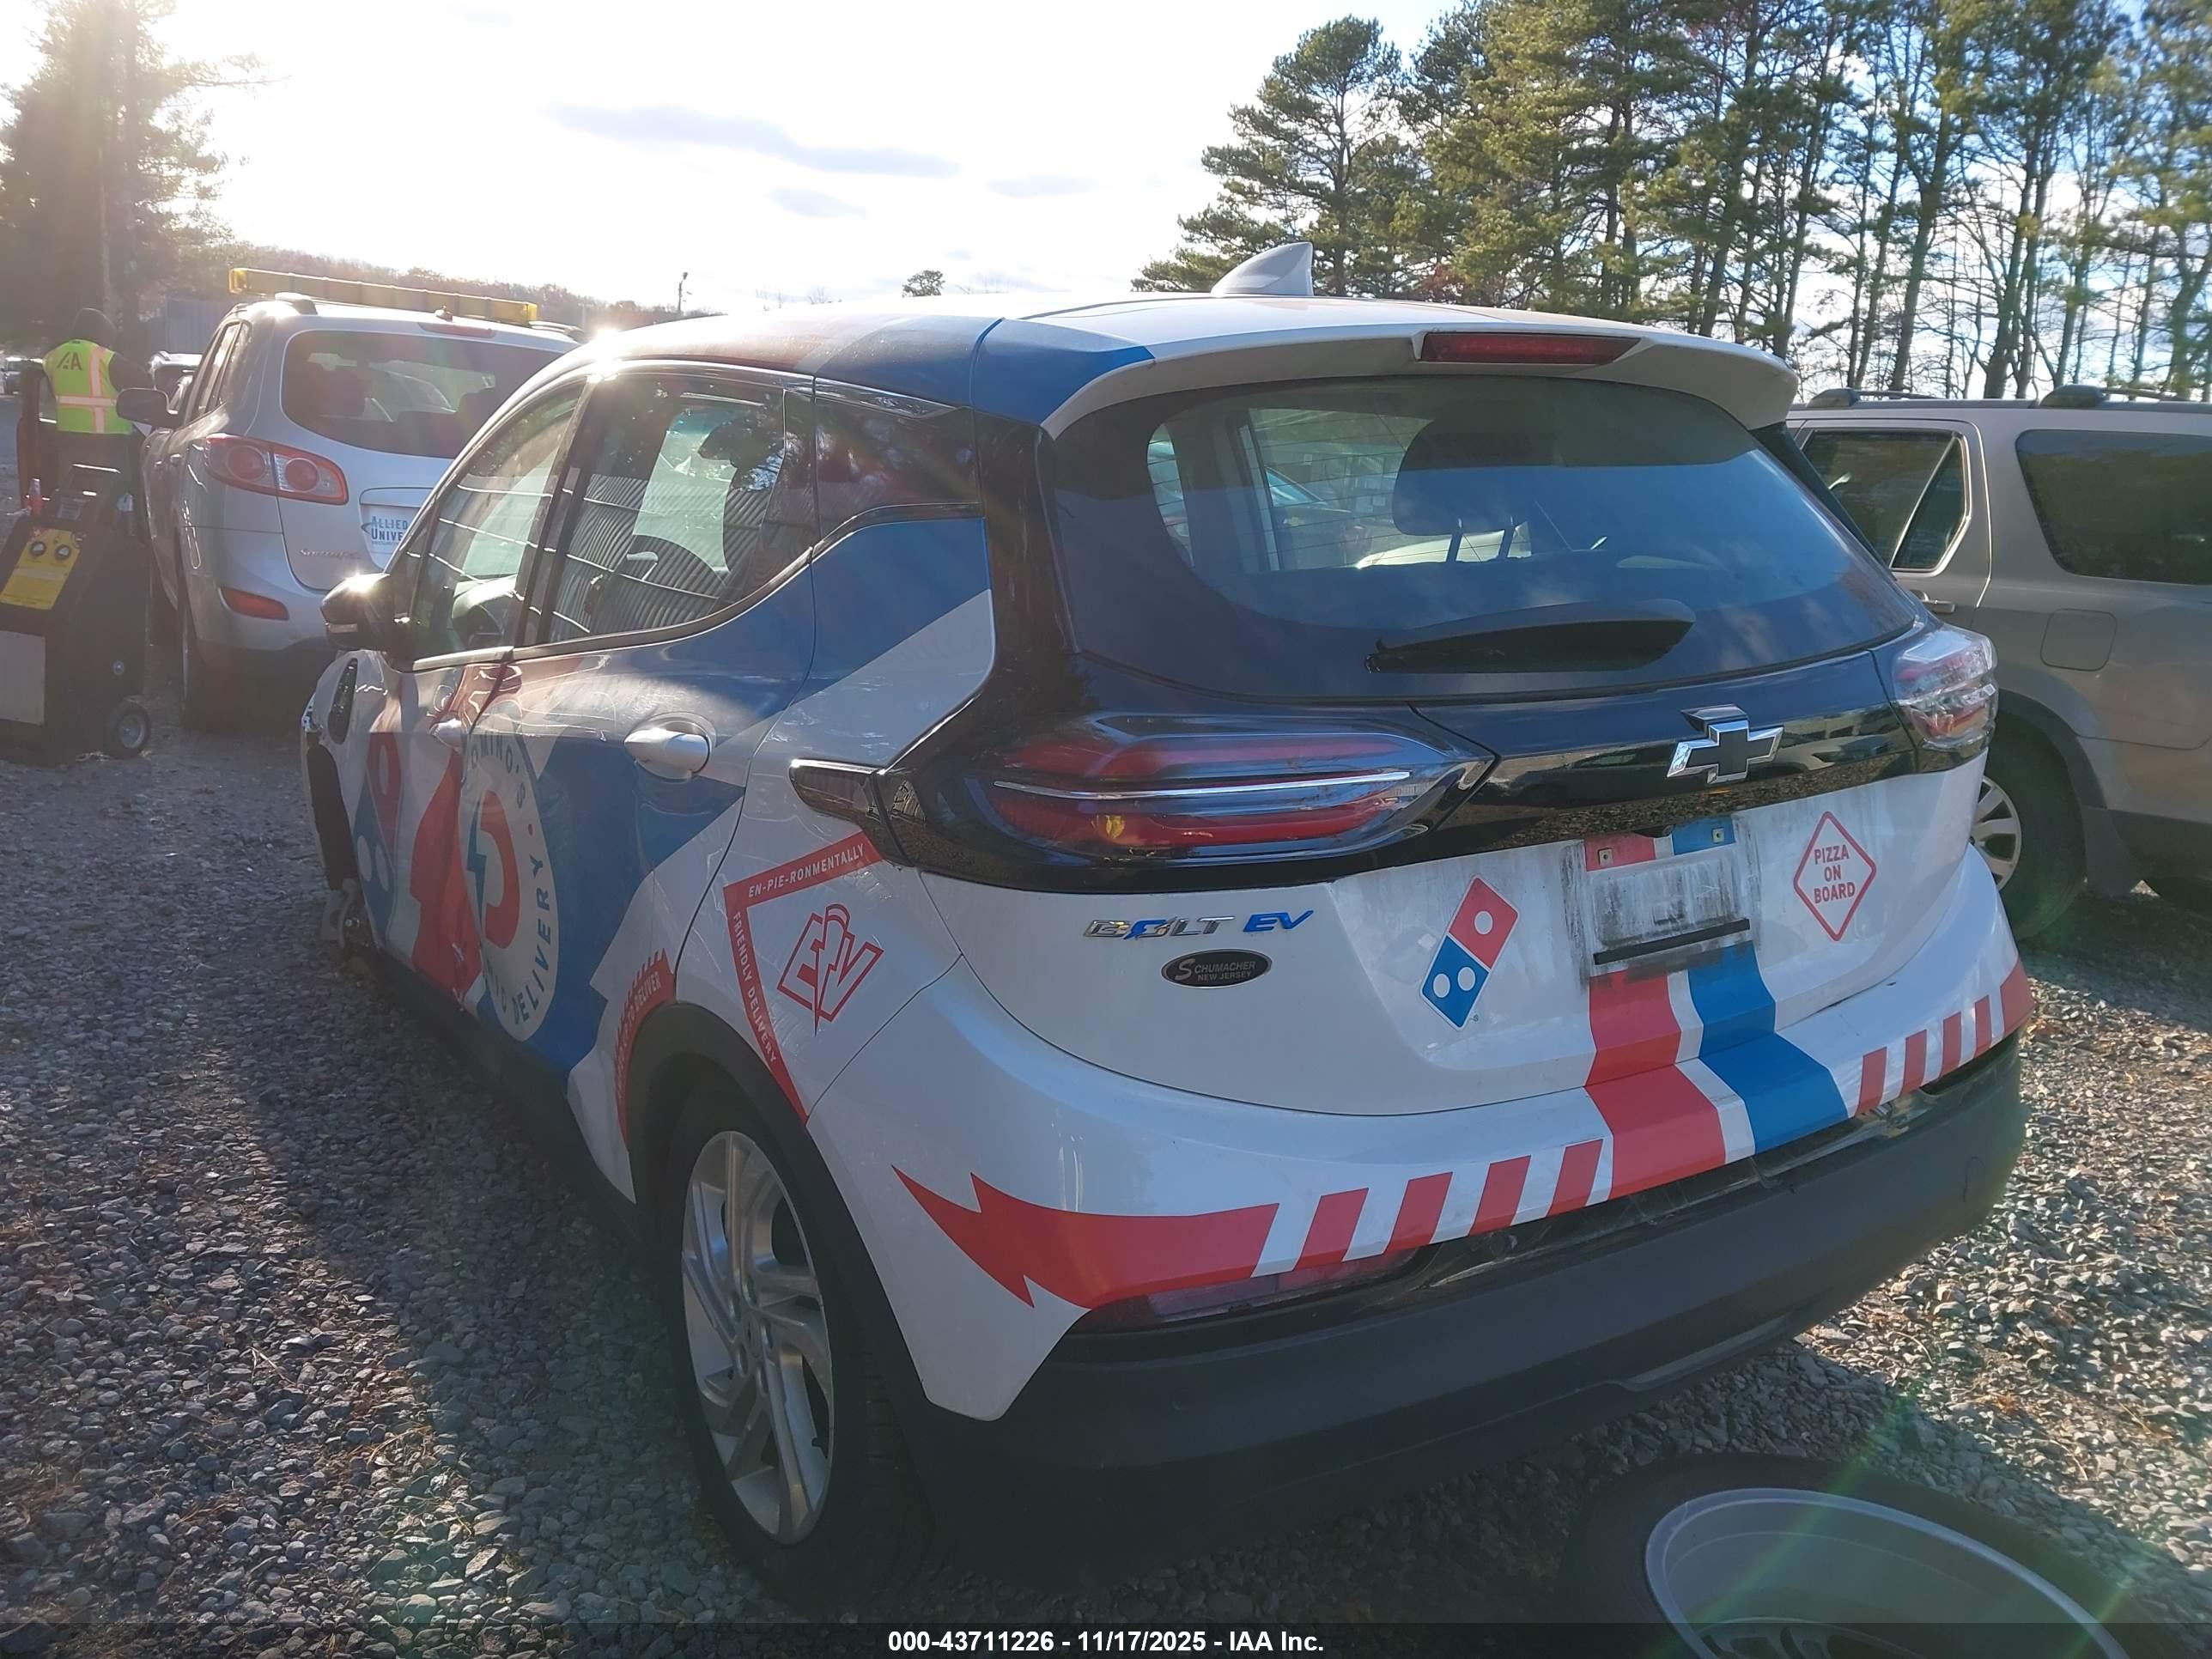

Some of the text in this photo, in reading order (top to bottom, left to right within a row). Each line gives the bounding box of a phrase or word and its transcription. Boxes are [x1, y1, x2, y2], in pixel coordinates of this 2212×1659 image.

[371, 516, 408, 530] ALLIED
[1814, 844, 1850, 865] PIZZA
[748, 843, 866, 898] EN-PIE-RONMENTALLY
[1824, 864, 1842, 883] ON
[1814, 882, 1856, 904] BOARD
[1085, 909, 1314, 940] BOLT EV
[512, 854, 551, 1024] DELIVERY
[1175, 958, 1256, 981] SCHUMACHER
[1197, 971, 1251, 982] NEW JERSEY
[732, 910, 777, 1063] FRIENDLY DELIVERY
